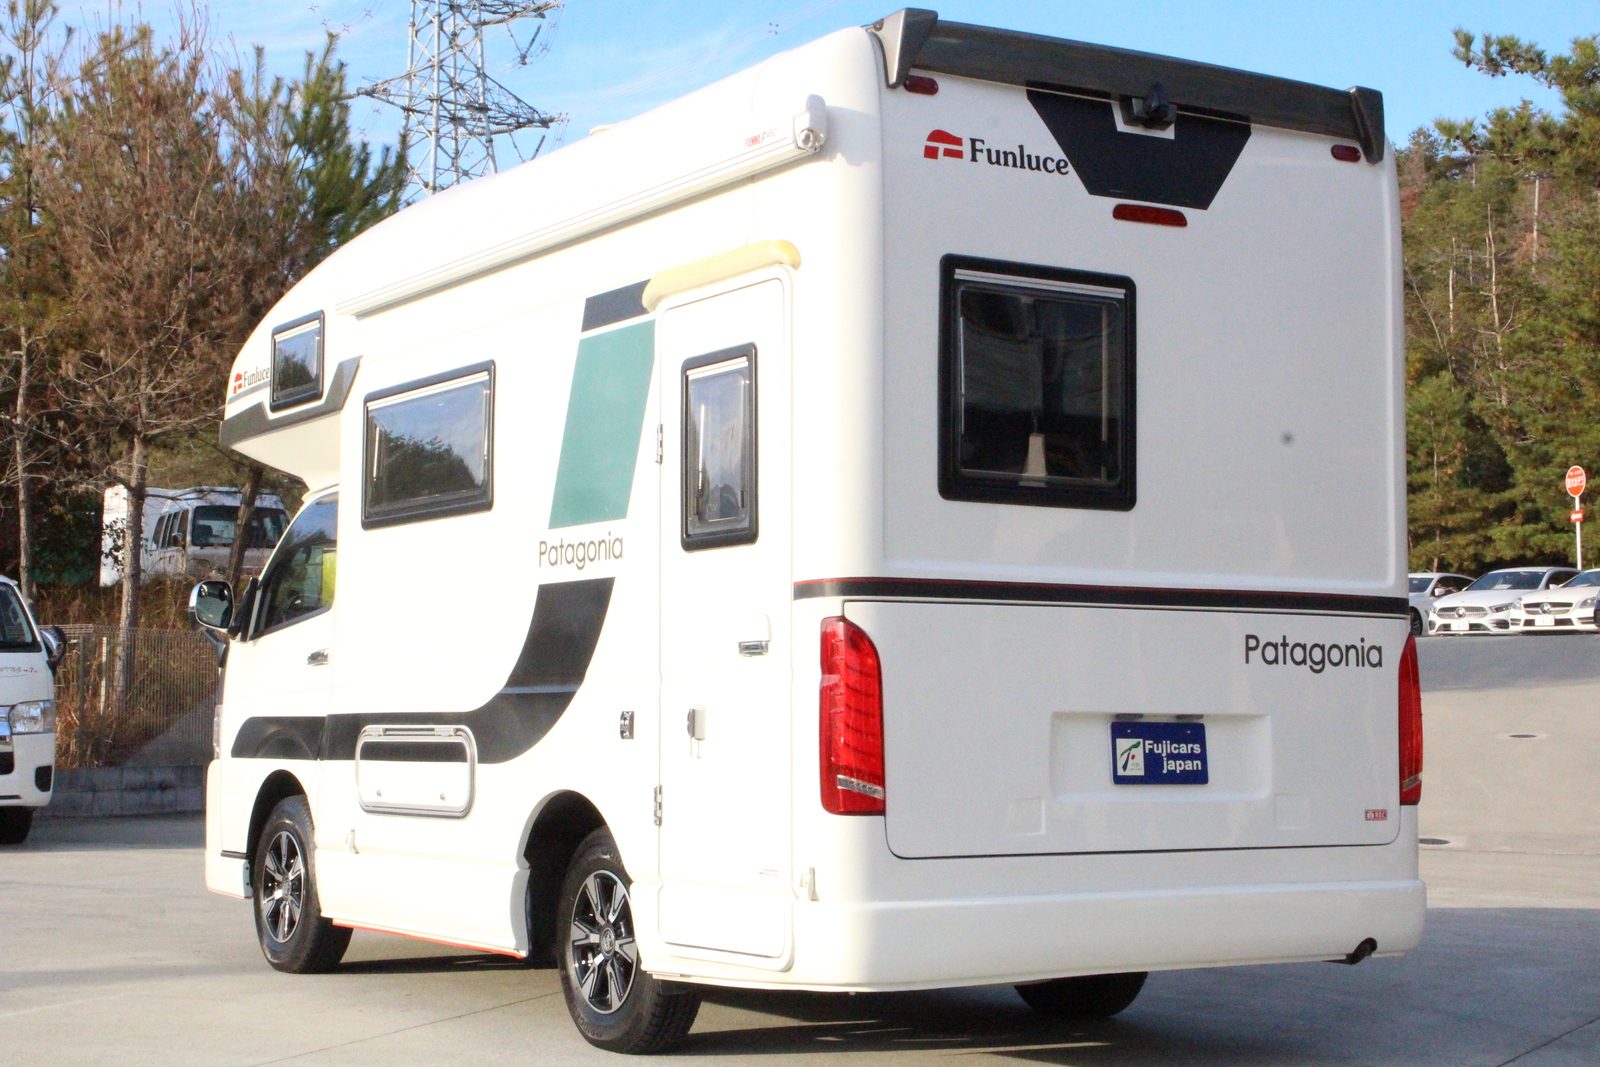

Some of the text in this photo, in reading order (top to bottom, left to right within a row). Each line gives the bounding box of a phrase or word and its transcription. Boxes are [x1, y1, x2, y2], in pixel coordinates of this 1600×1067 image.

[969, 137, 1069, 175] Funluce
[243, 366, 270, 388] Funluce
[538, 531, 623, 570] Patagonia
[1245, 634, 1382, 674] Patagonia
[1144, 740, 1201, 756] Fujicars
[1162, 757, 1202, 773] japan
